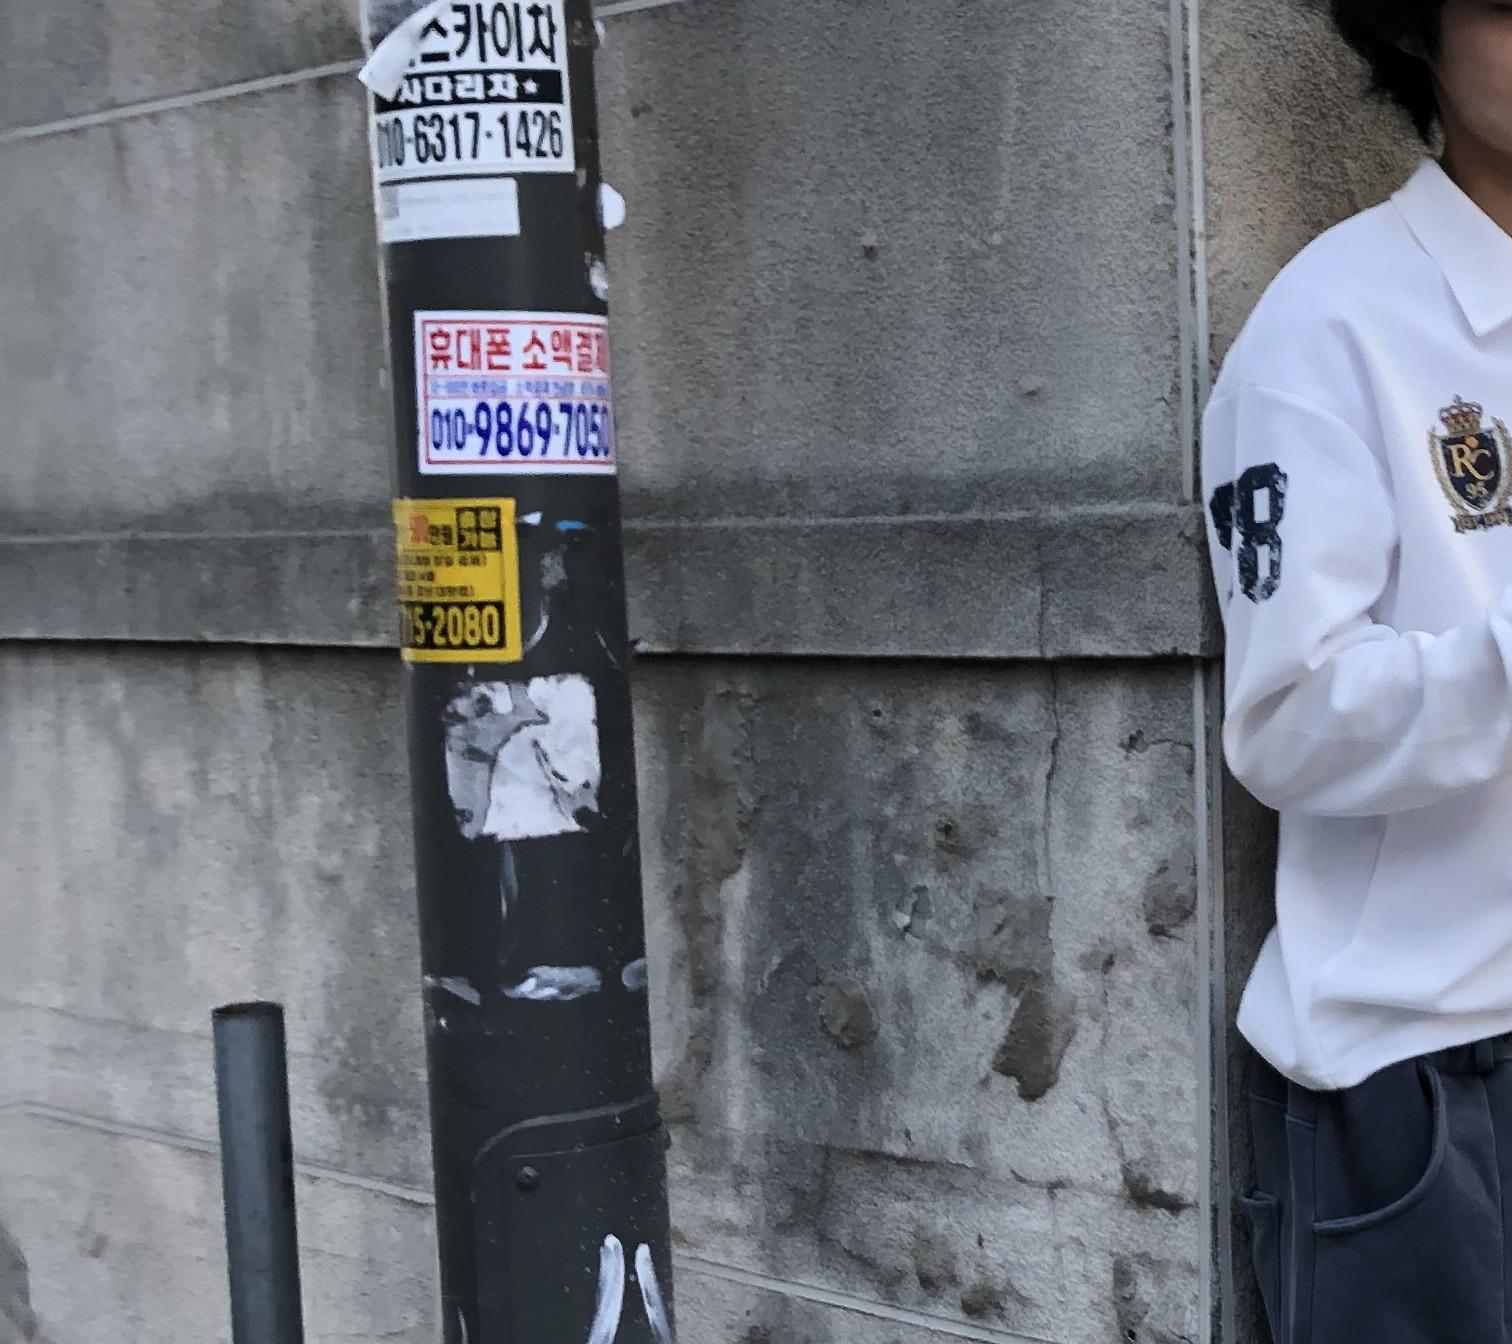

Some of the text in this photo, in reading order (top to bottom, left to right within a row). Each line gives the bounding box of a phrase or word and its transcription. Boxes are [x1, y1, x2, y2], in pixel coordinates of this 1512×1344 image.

[420, 3, 556, 63] 스카이차
[430, 328, 511, 371] 휴대폰
[1446, 444, 1495, 480] RC
